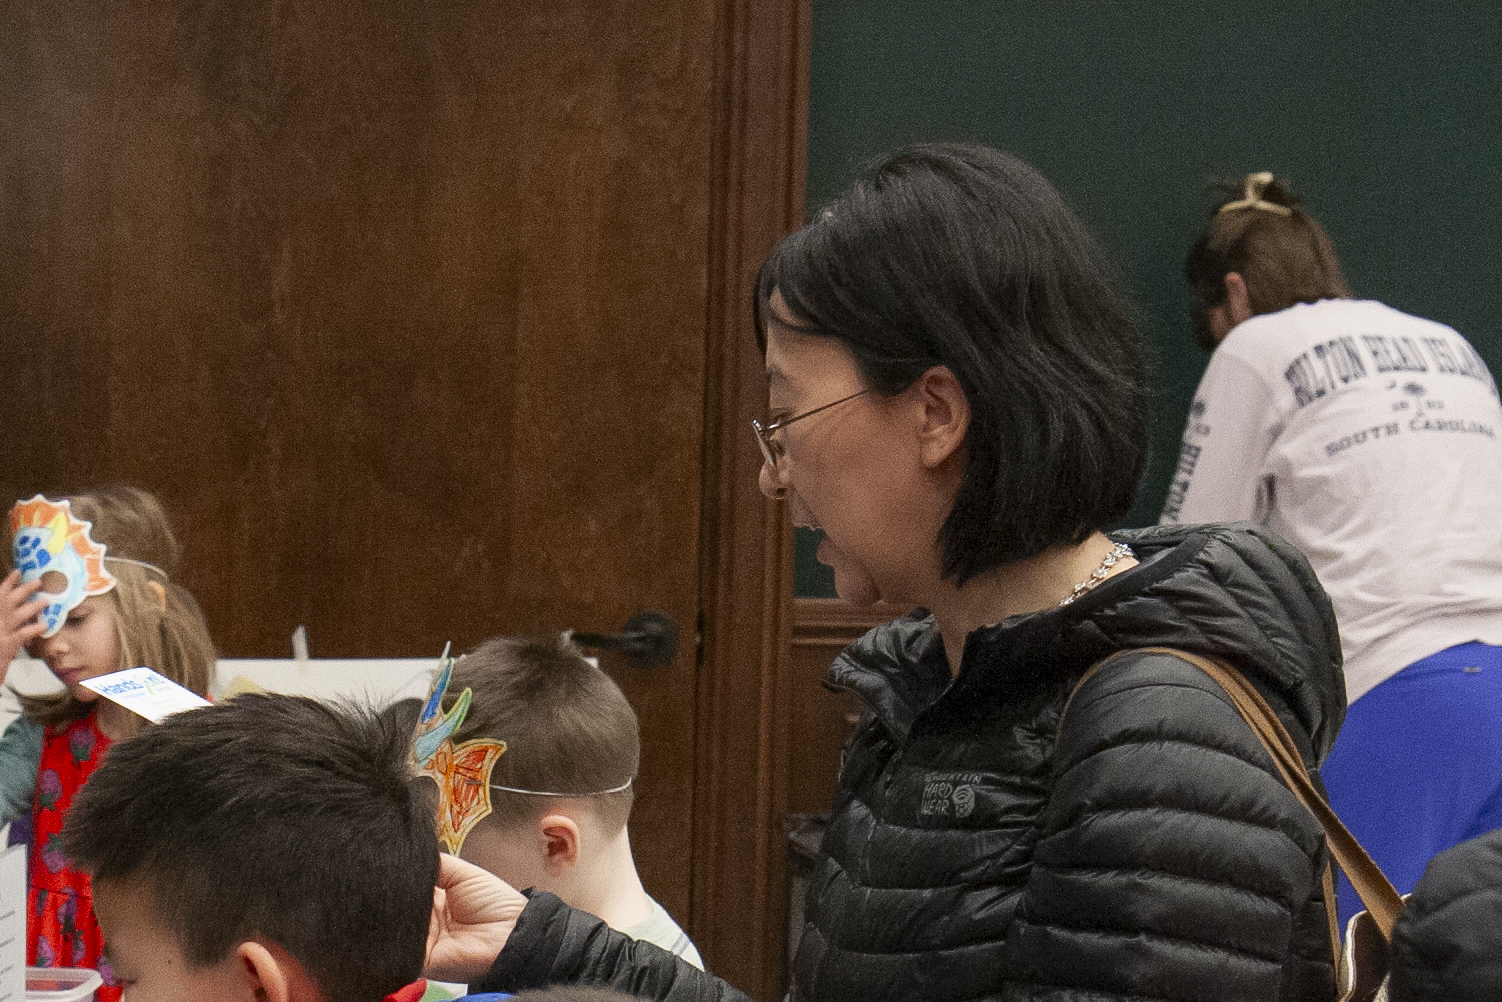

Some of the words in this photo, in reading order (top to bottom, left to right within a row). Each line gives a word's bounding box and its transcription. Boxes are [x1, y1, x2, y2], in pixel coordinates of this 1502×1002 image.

[1324, 421, 1400, 457] SOUTH
[922, 782, 954, 799] HARD
[920, 799, 950, 816] WEAR
